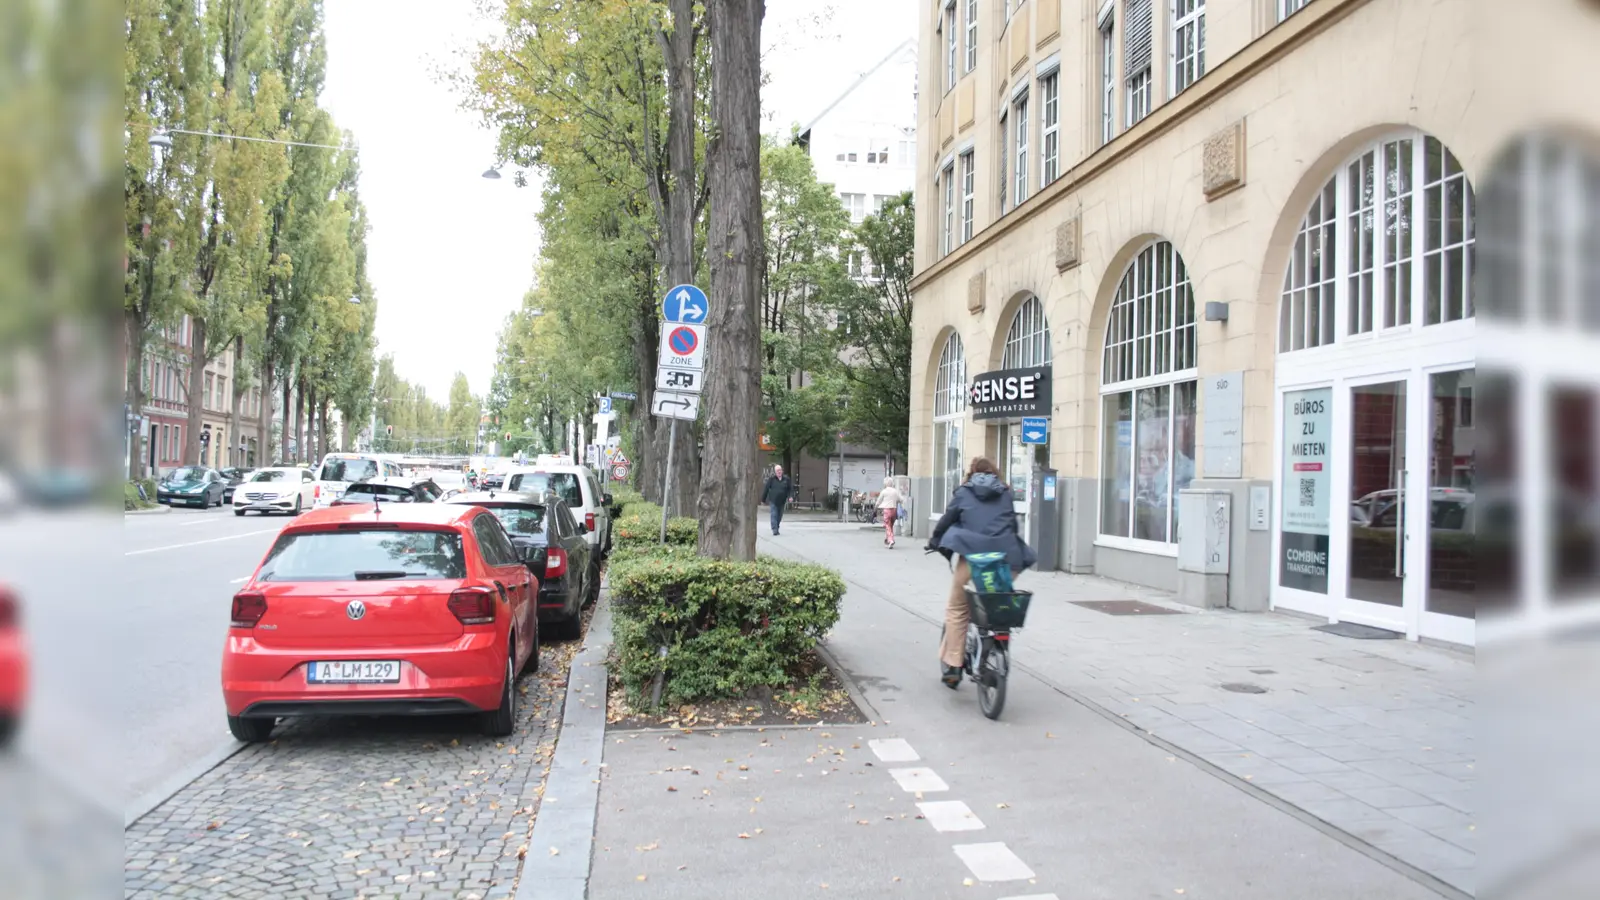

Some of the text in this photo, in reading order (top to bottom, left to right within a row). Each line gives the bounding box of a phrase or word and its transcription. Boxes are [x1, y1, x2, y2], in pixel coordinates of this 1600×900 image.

[670, 356, 692, 365] ZONE
[990, 404, 1036, 412] MATRATZEN
[1293, 398, 1325, 415] BÜROS
[1302, 422, 1315, 435] ZU
[1292, 442, 1325, 456] MIETEN
[1286, 548, 1326, 565] COMBINE
[1286, 562, 1326, 576] TRANSACTION
